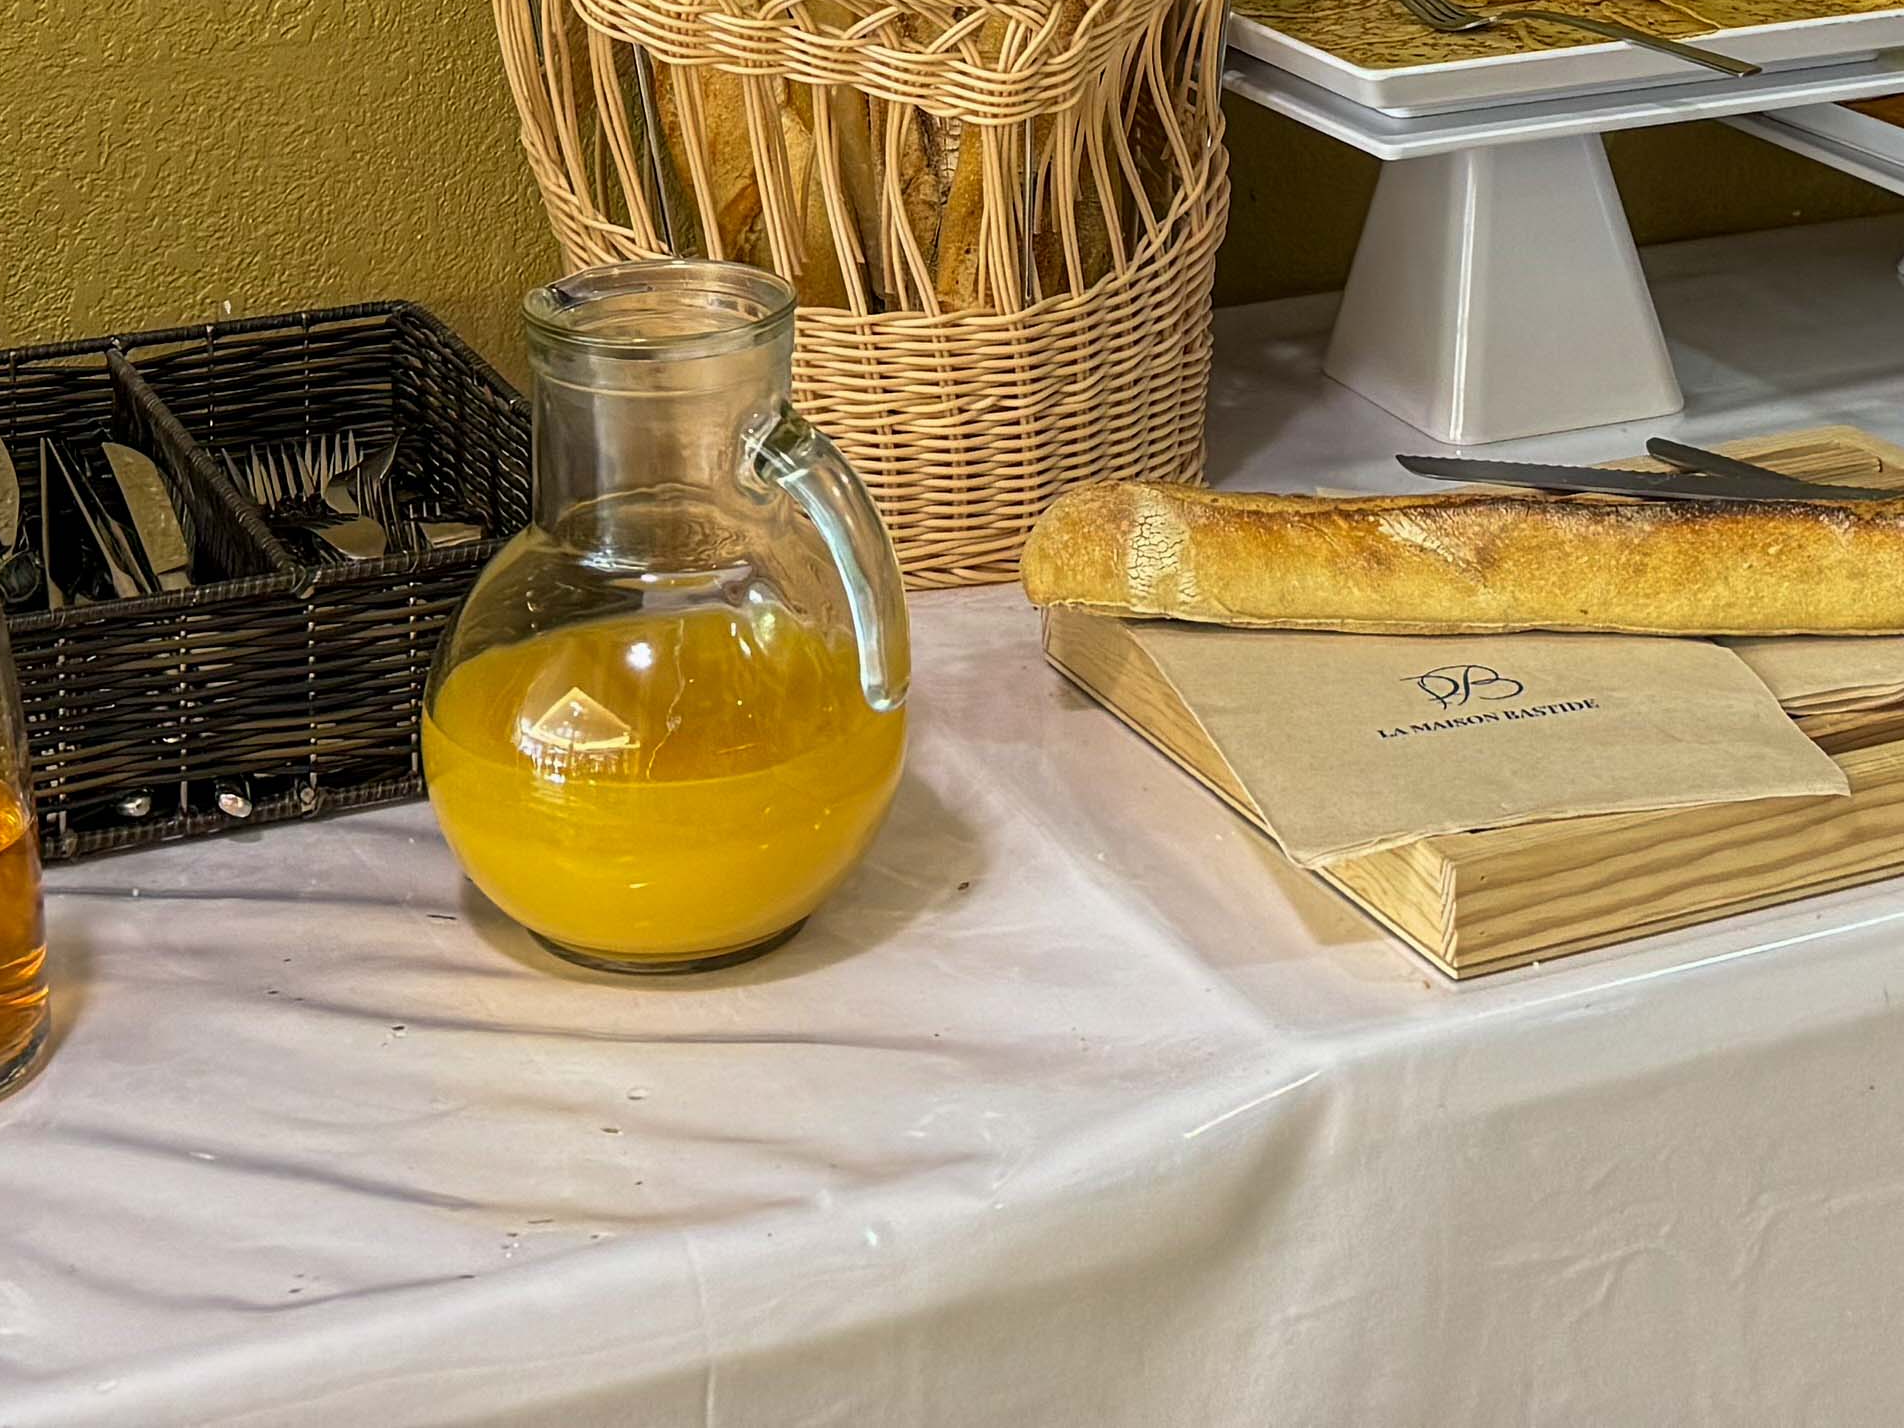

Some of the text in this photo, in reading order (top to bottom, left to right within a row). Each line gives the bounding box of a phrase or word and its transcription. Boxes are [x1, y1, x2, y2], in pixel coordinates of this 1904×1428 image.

[1377, 698, 1600, 739] LA MAISON BASTIDE
